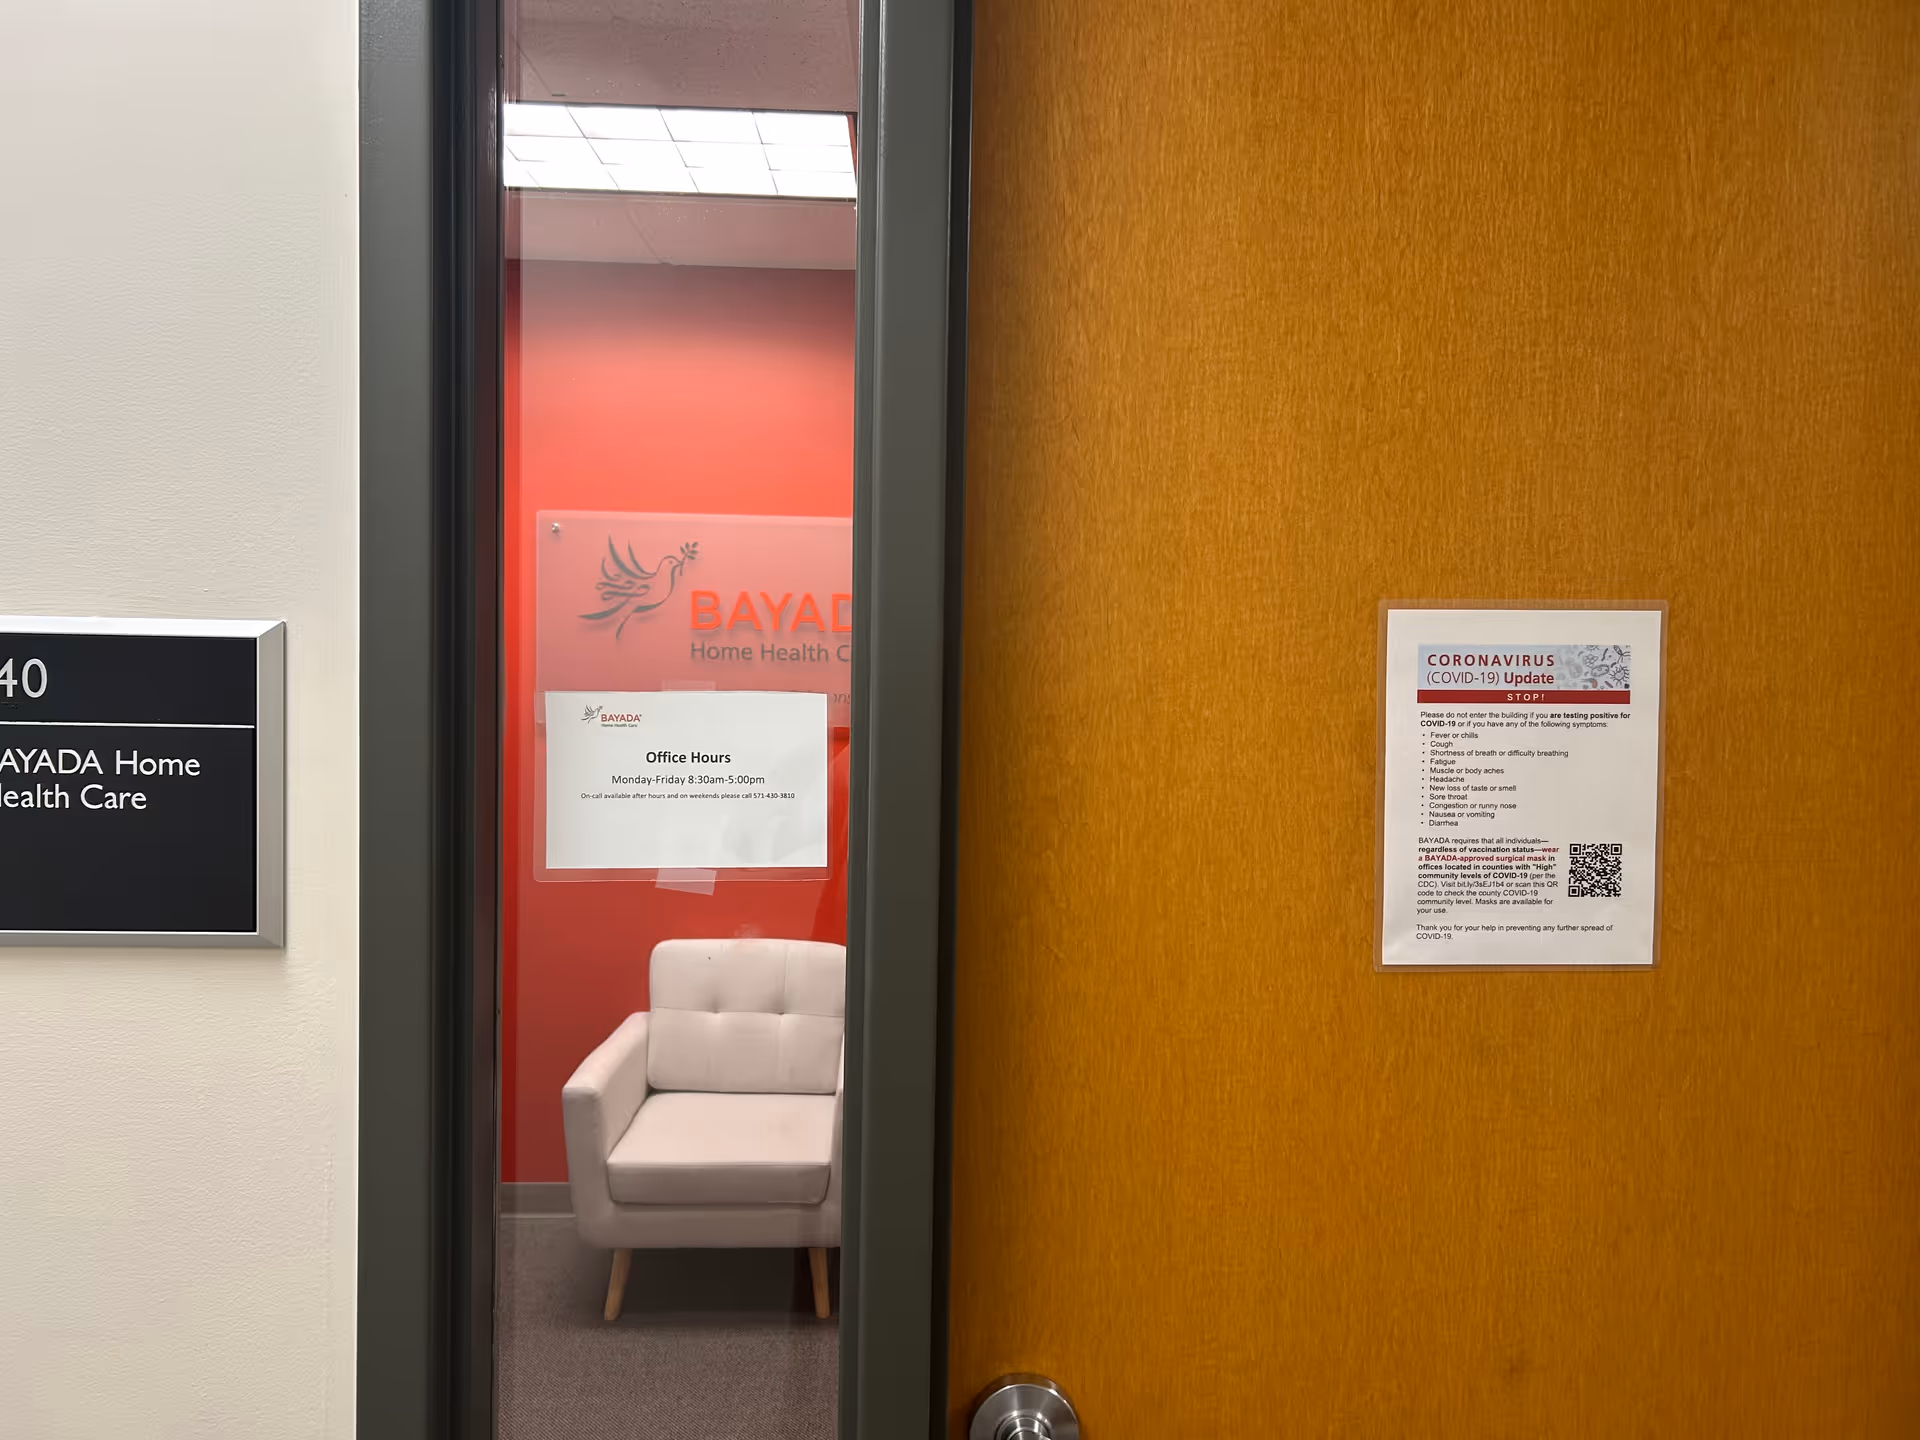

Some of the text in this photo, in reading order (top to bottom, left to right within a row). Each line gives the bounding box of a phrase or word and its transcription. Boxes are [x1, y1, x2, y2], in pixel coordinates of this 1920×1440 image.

[690, 589, 852, 632] BAYAD
[691, 641, 753, 662] Home
[761, 643, 829, 663] Health
[1427, 654, 1555, 667] CORONAVIRUS
[1426, 671, 1555, 687] (COVID-19) Update
[1506, 693, 1545, 702] STOP!
[1420, 711, 1445, 719] Please
[1445, 711, 1455, 719] do
[1501, 712, 1528, 720] building
[1563, 712, 1589, 721] testing
[1590, 712, 1619, 720] positive
[1472, 721, 1486, 729] you
[1519, 720, 1527, 728] of
[1540, 720, 1571, 729] following
[1572, 721, 1608, 729] symptoms:
[1430, 731, 1451, 739] Fever
[1430, 740, 1454, 749] Cough
[646, 750, 731, 764] Office Hours
[1430, 749, 1465, 757] Shortness
[1466, 749, 1474, 757] of
[1507, 749, 1536, 758] difficulty
[1537, 750, 1569, 758] breathing
[0, 748, 201, 776] AYADA Home
[1430, 758, 1456, 767] Fatigue
[1464, 767, 1482, 776] body
[612, 775, 765, 786] Monday-Friday 8:30am-5:00pm
[1429, 784, 1446, 792] New
[1446, 784, 1461, 792] loss
[1462, 784, 1470, 792] of
[80, 783, 147, 810] Care
[720, 792, 740, 800] please
[1429, 793, 1446, 801] Sore
[1428, 802, 1469, 811] Congestion
[1478, 803, 1499, 811] runny
[1466, 811, 1495, 820] vomiting
[1428, 819, 1459, 827] Diarrhea
[1418, 836, 1451, 844] BAYADA
[1418, 846, 1458, 854] regardless
[1424, 854, 1494, 863] BAYADA-approved
[1495, 855, 1525, 863] surgical
[1417, 863, 1443, 871] offices
[1444, 863, 1472, 871] located
[1417, 872, 1459, 881] community
[1529, 872, 1544, 881] (per
[1417, 880, 1439, 889] CDC).
[1440, 880, 1456, 888] Visit
[1546, 880, 1559, 888] QR
[1478, 890, 1502, 898] county
[1502, 889, 1539, 897] COVID-19
[1416, 898, 1455, 907] community
[1439, 925, 1452, 933] you
[1464, 925, 1480, 933] your
[1481, 924, 1497, 932] help
[1505, 925, 1542, 933] preventing
[1542, 925, 1556, 933] any
[1556, 924, 1580, 932] further
[1580, 924, 1605, 932] spread
[1605, 924, 1614, 932] of
[1415, 932, 1454, 940] COVID-19.
